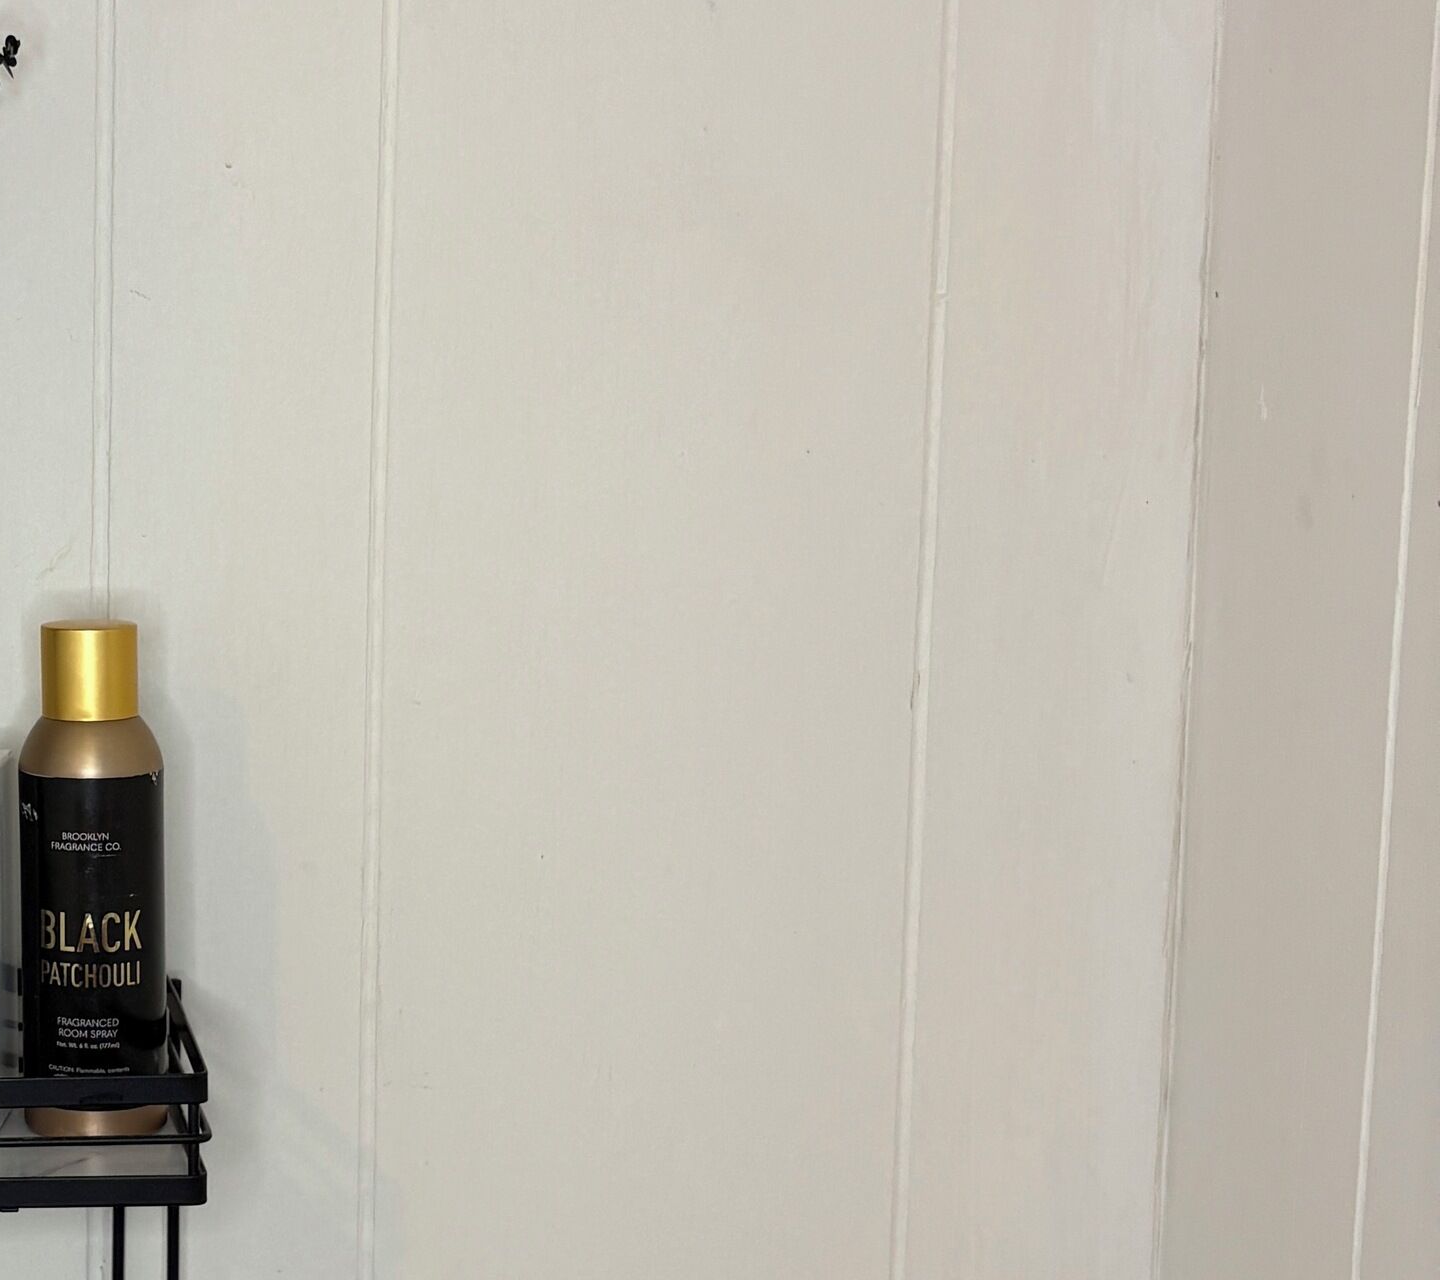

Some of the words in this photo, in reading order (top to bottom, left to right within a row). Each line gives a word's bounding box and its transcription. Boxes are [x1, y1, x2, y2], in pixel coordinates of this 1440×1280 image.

[61, 831, 110, 842] BROOKLYN
[50, 840, 103, 852] FRAGRANCE
[105, 841, 122, 852] CO.
[40, 908, 143, 954] BLACK
[40, 959, 141, 989] PATCHOULI
[56, 1016, 120, 1028] FRAGRANCED
[58, 1027, 88, 1038] ROOM
[90, 1028, 118, 1039] SPRAY
